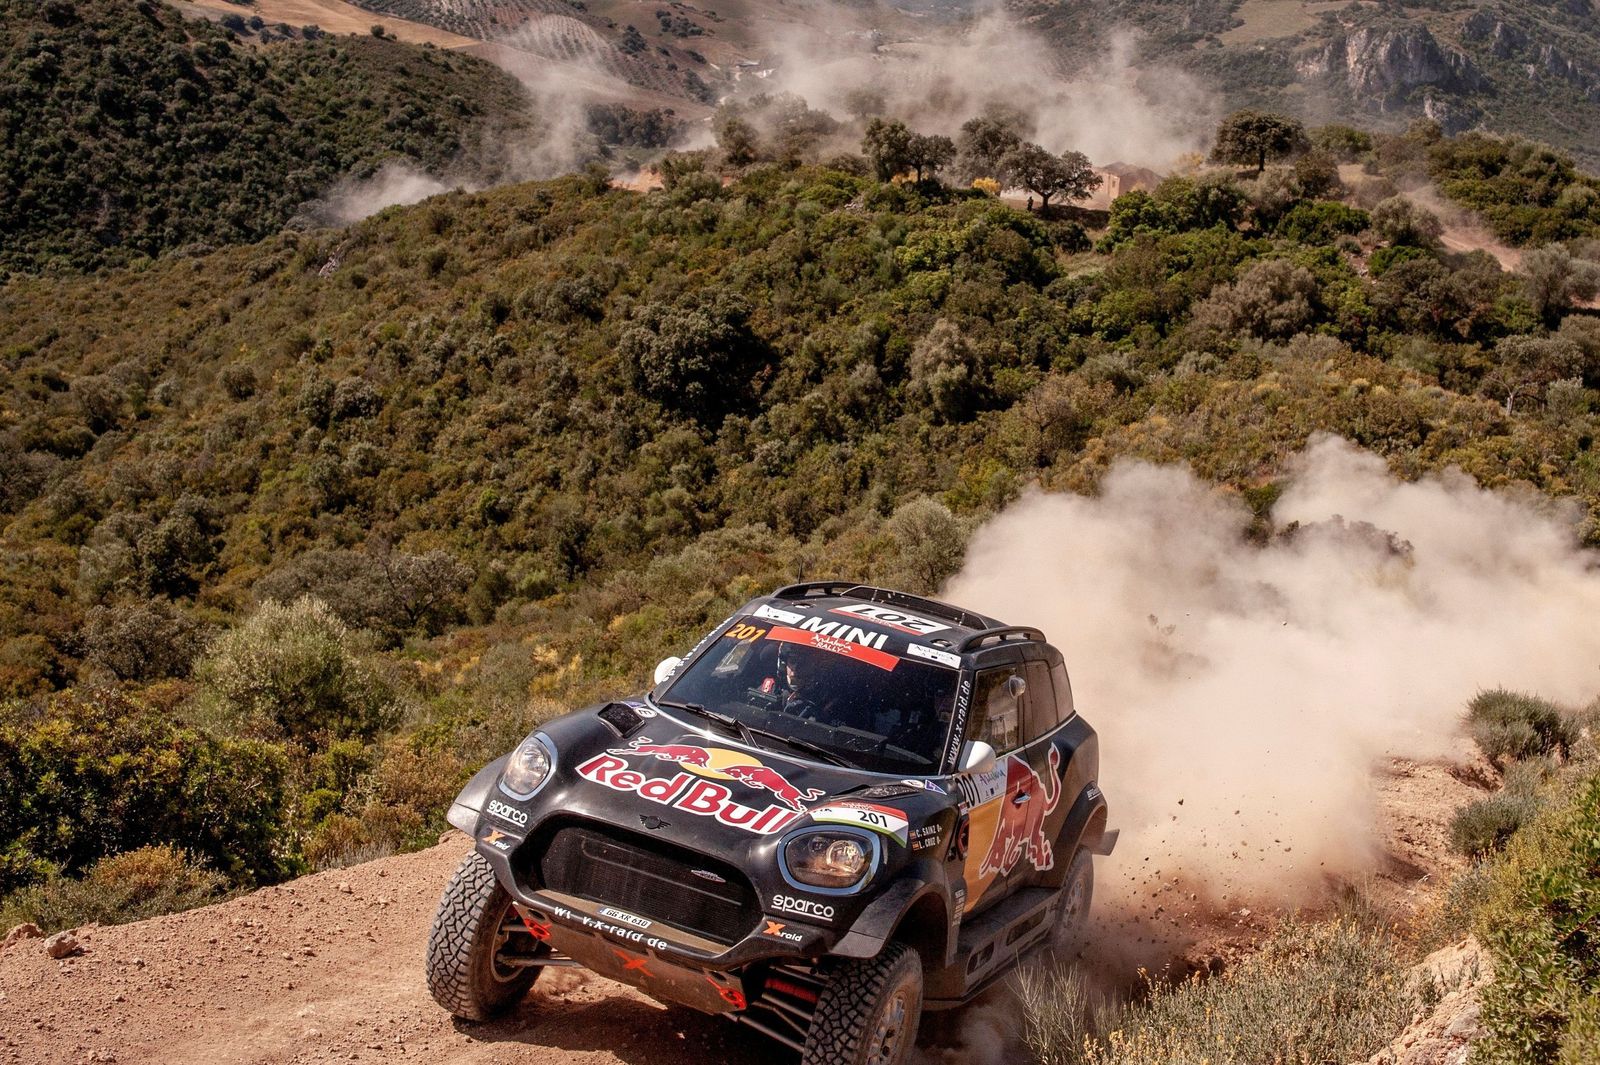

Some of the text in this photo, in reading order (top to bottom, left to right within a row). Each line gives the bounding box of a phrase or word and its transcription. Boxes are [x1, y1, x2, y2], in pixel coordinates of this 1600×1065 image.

[725, 623, 766, 643] 201
[799, 616, 889, 650] MINI
[814, 641, 844, 654] RALLY
[947, 680, 971, 766] www.x-raid.de
[575, 752, 799, 834] Red Bull
[487, 800, 528, 827] sparco
[857, 810, 888, 828] 201
[606, 909, 648, 927] GG XR 610
[771, 894, 835, 921] sparco
